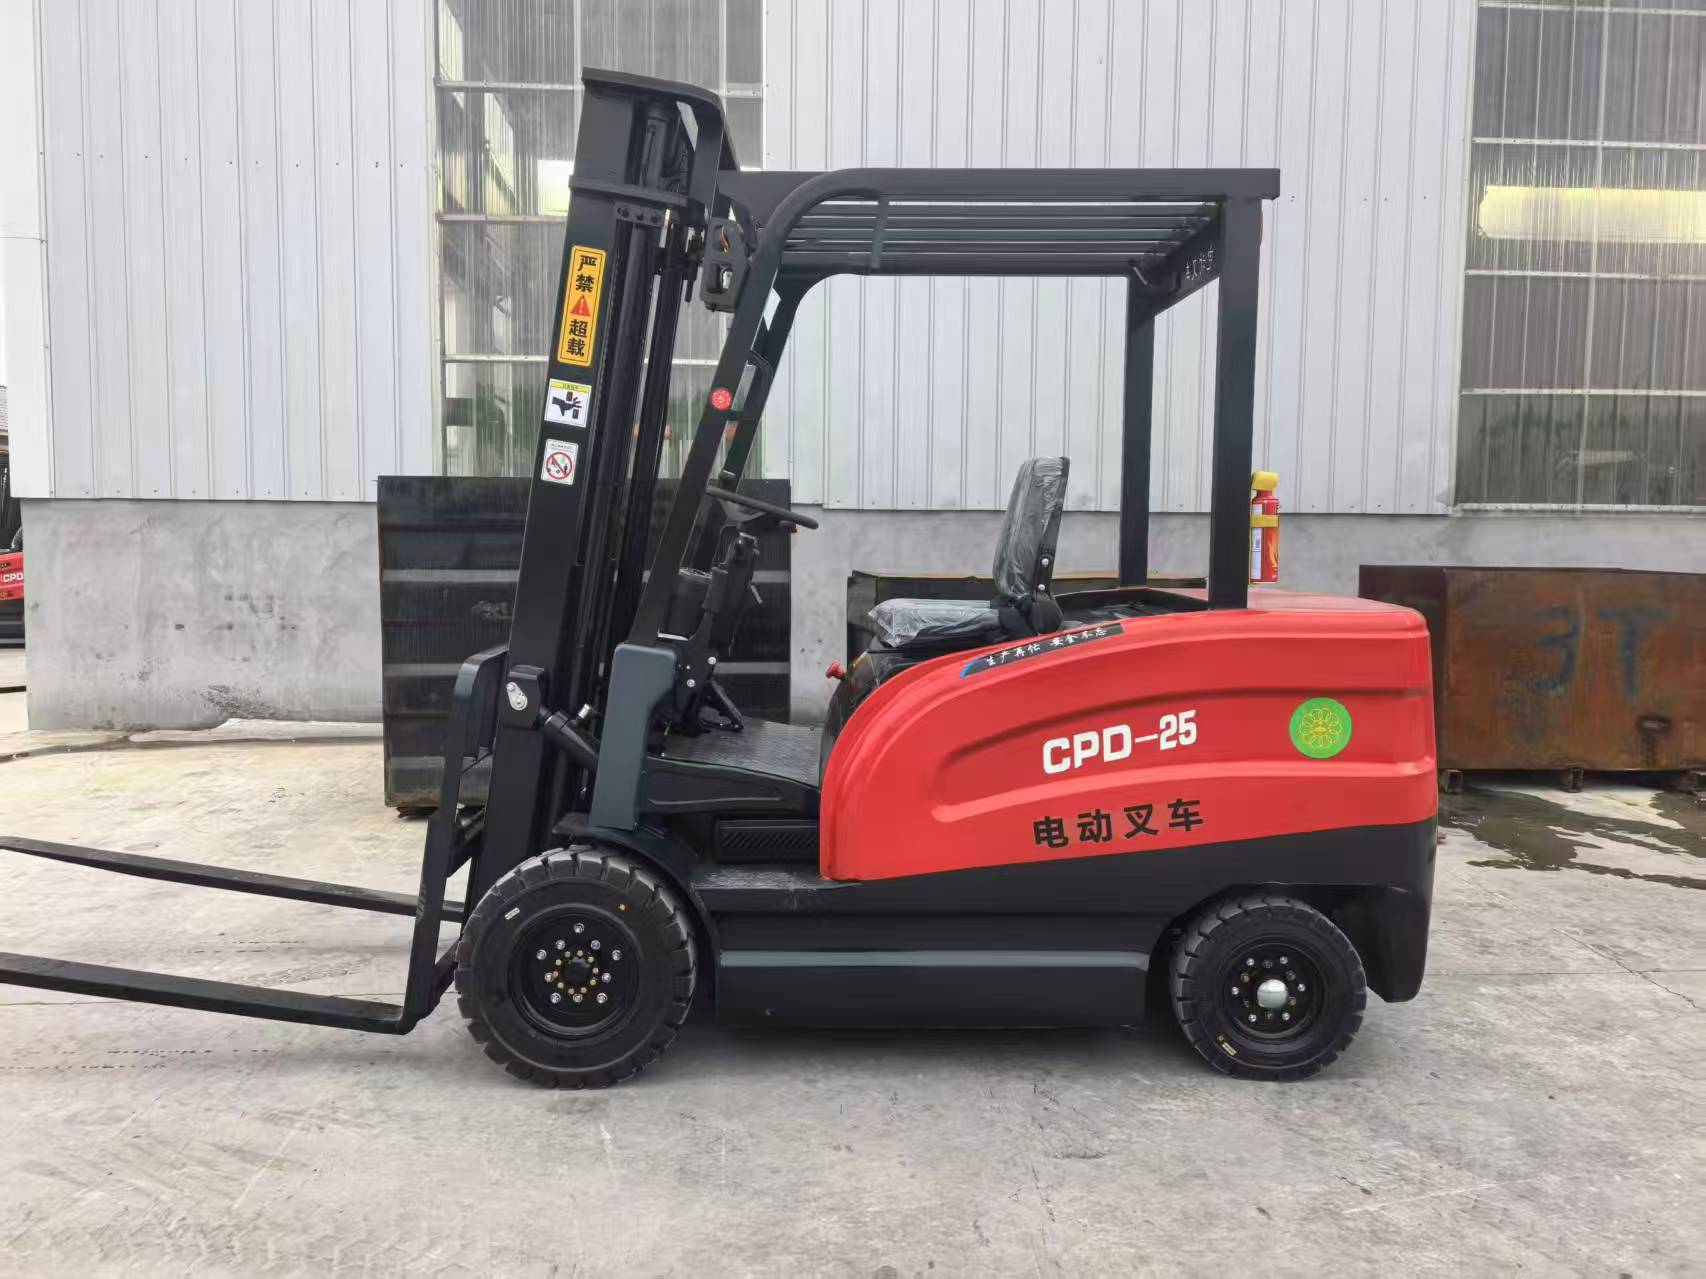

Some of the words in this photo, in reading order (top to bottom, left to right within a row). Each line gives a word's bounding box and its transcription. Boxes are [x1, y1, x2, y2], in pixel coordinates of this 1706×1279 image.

[575, 255, 598, 293] 严禁
[566, 319, 588, 357] 超载
[986, 643, 1041, 666] 生产再忙
[1042, 709, 1198, 775] CPD-25
[1032, 797, 1204, 849] 电动叉车
